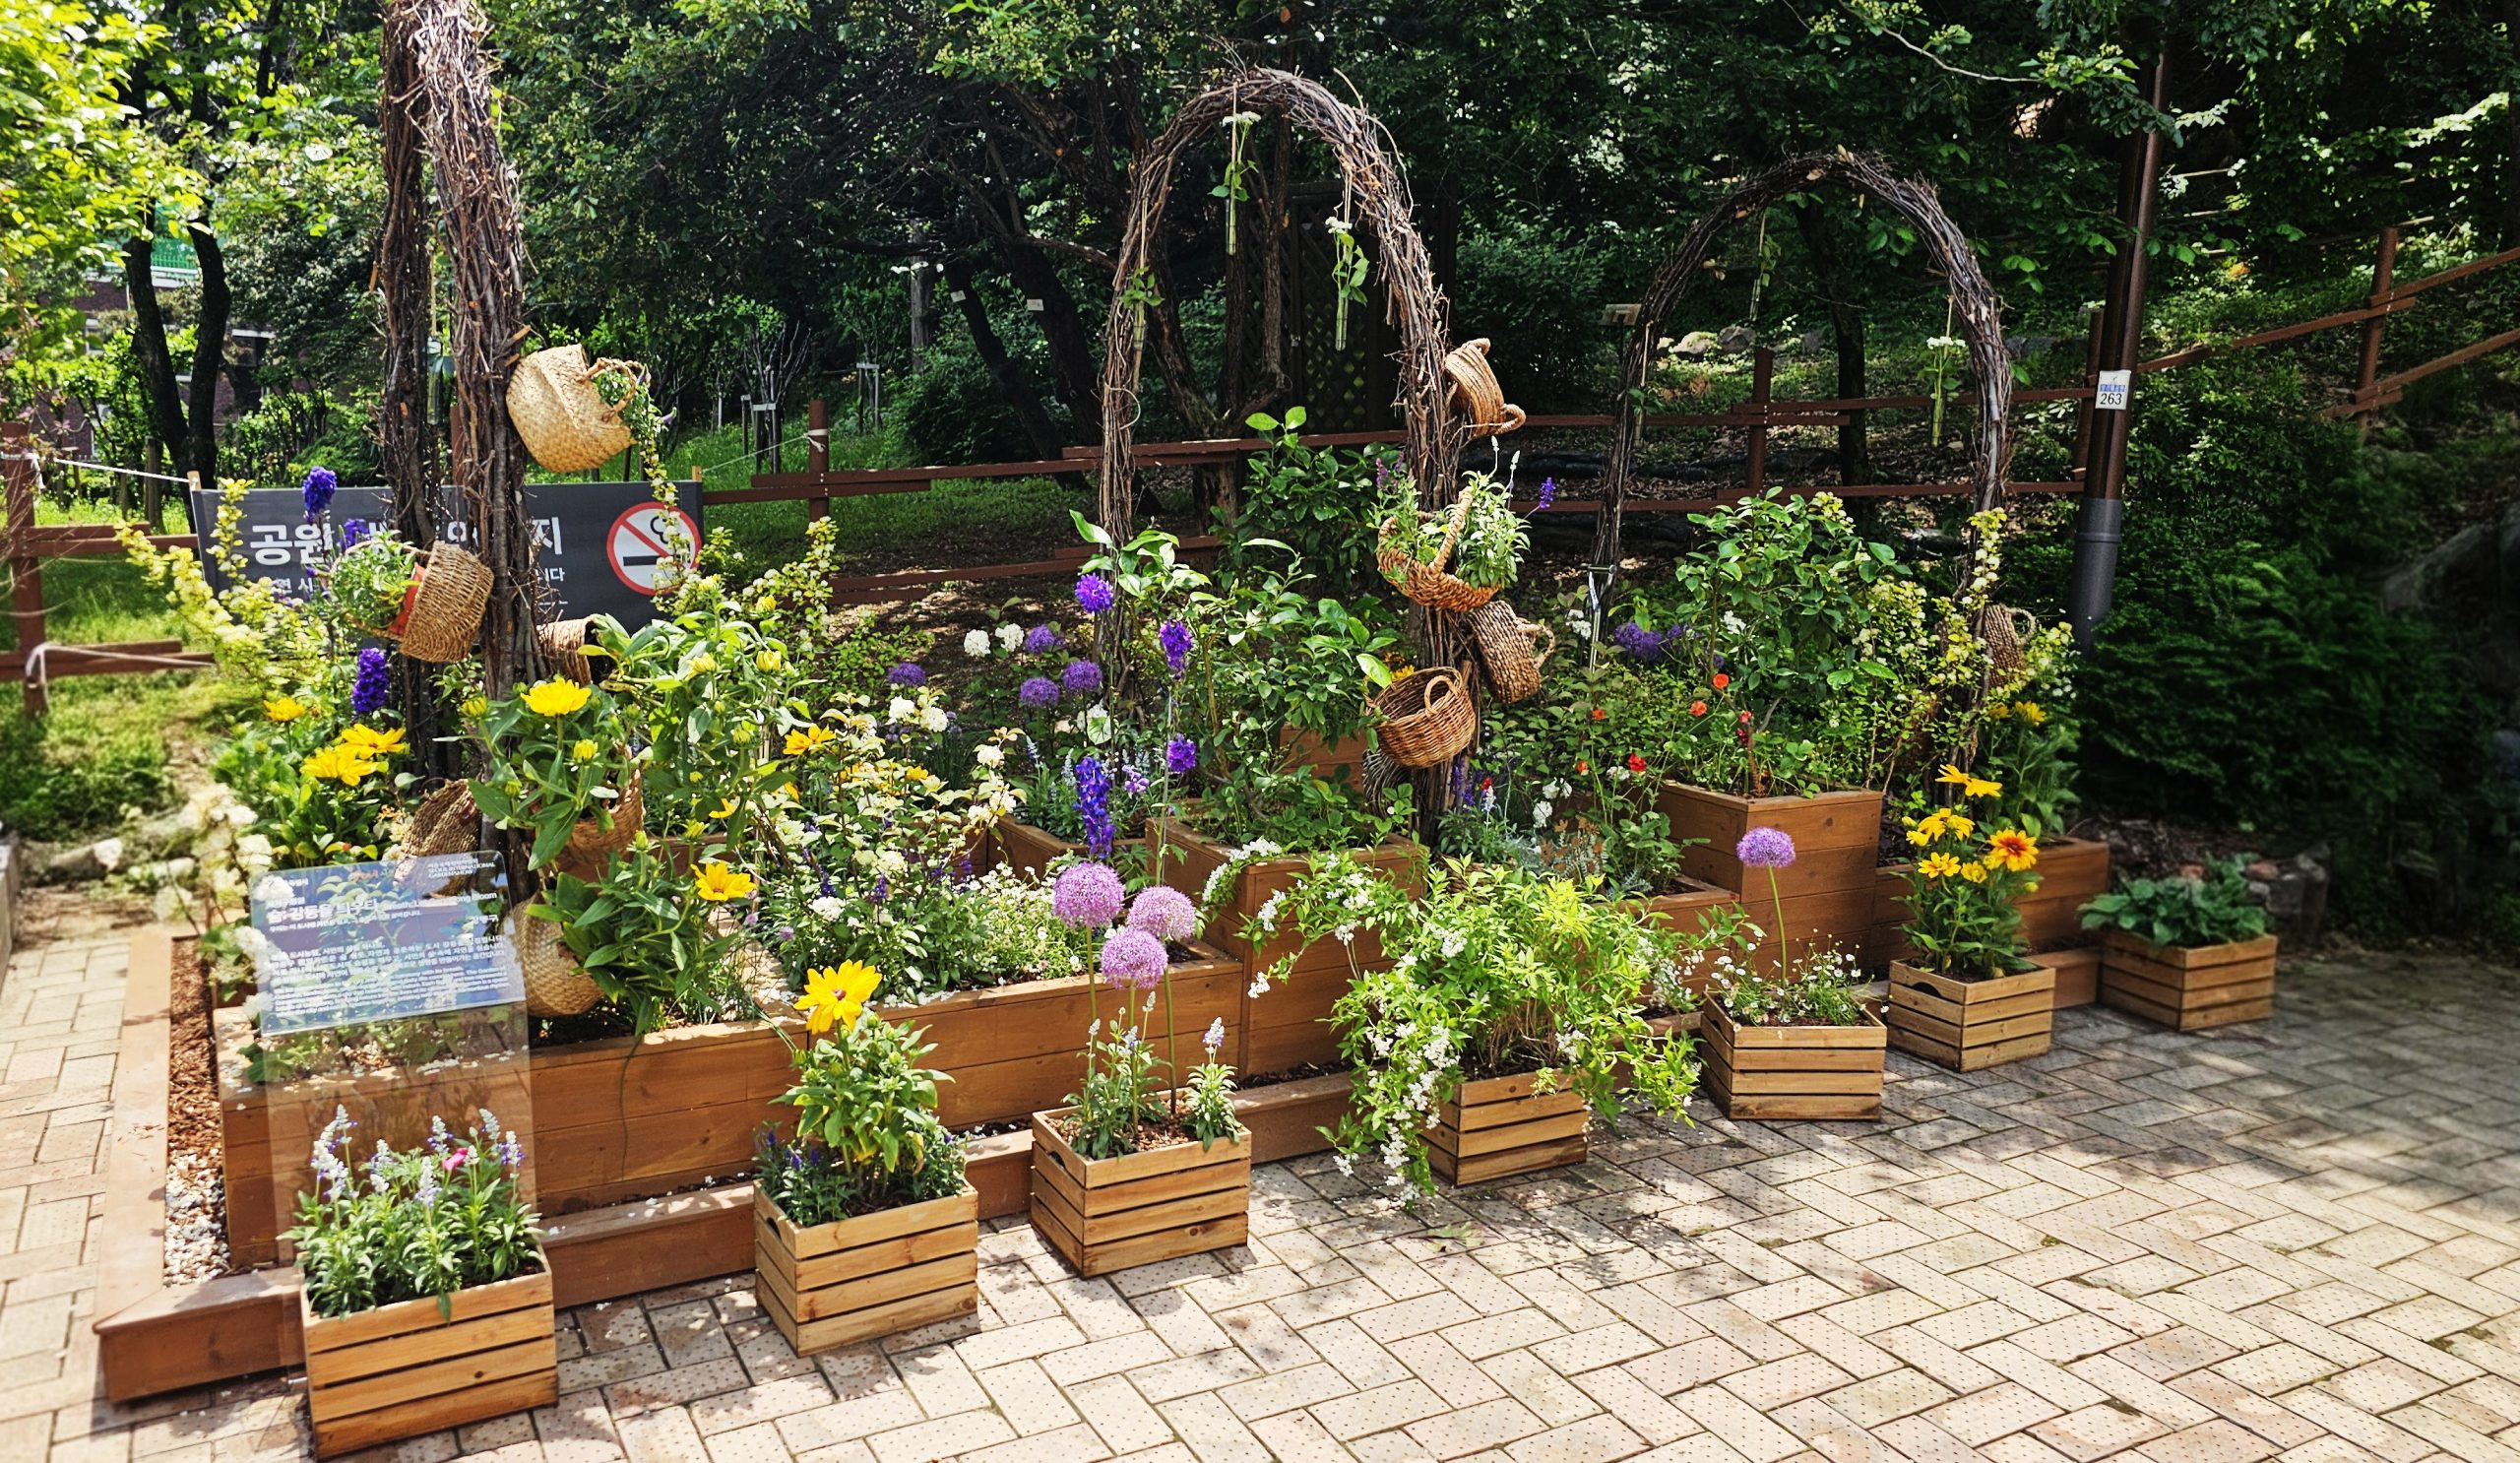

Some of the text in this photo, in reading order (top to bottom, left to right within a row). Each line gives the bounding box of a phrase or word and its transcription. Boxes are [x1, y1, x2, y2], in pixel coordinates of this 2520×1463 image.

[2100, 393, 2121, 405] 263
[250, 524, 334, 566] 공원
[472, 891, 498, 903] Bloom
